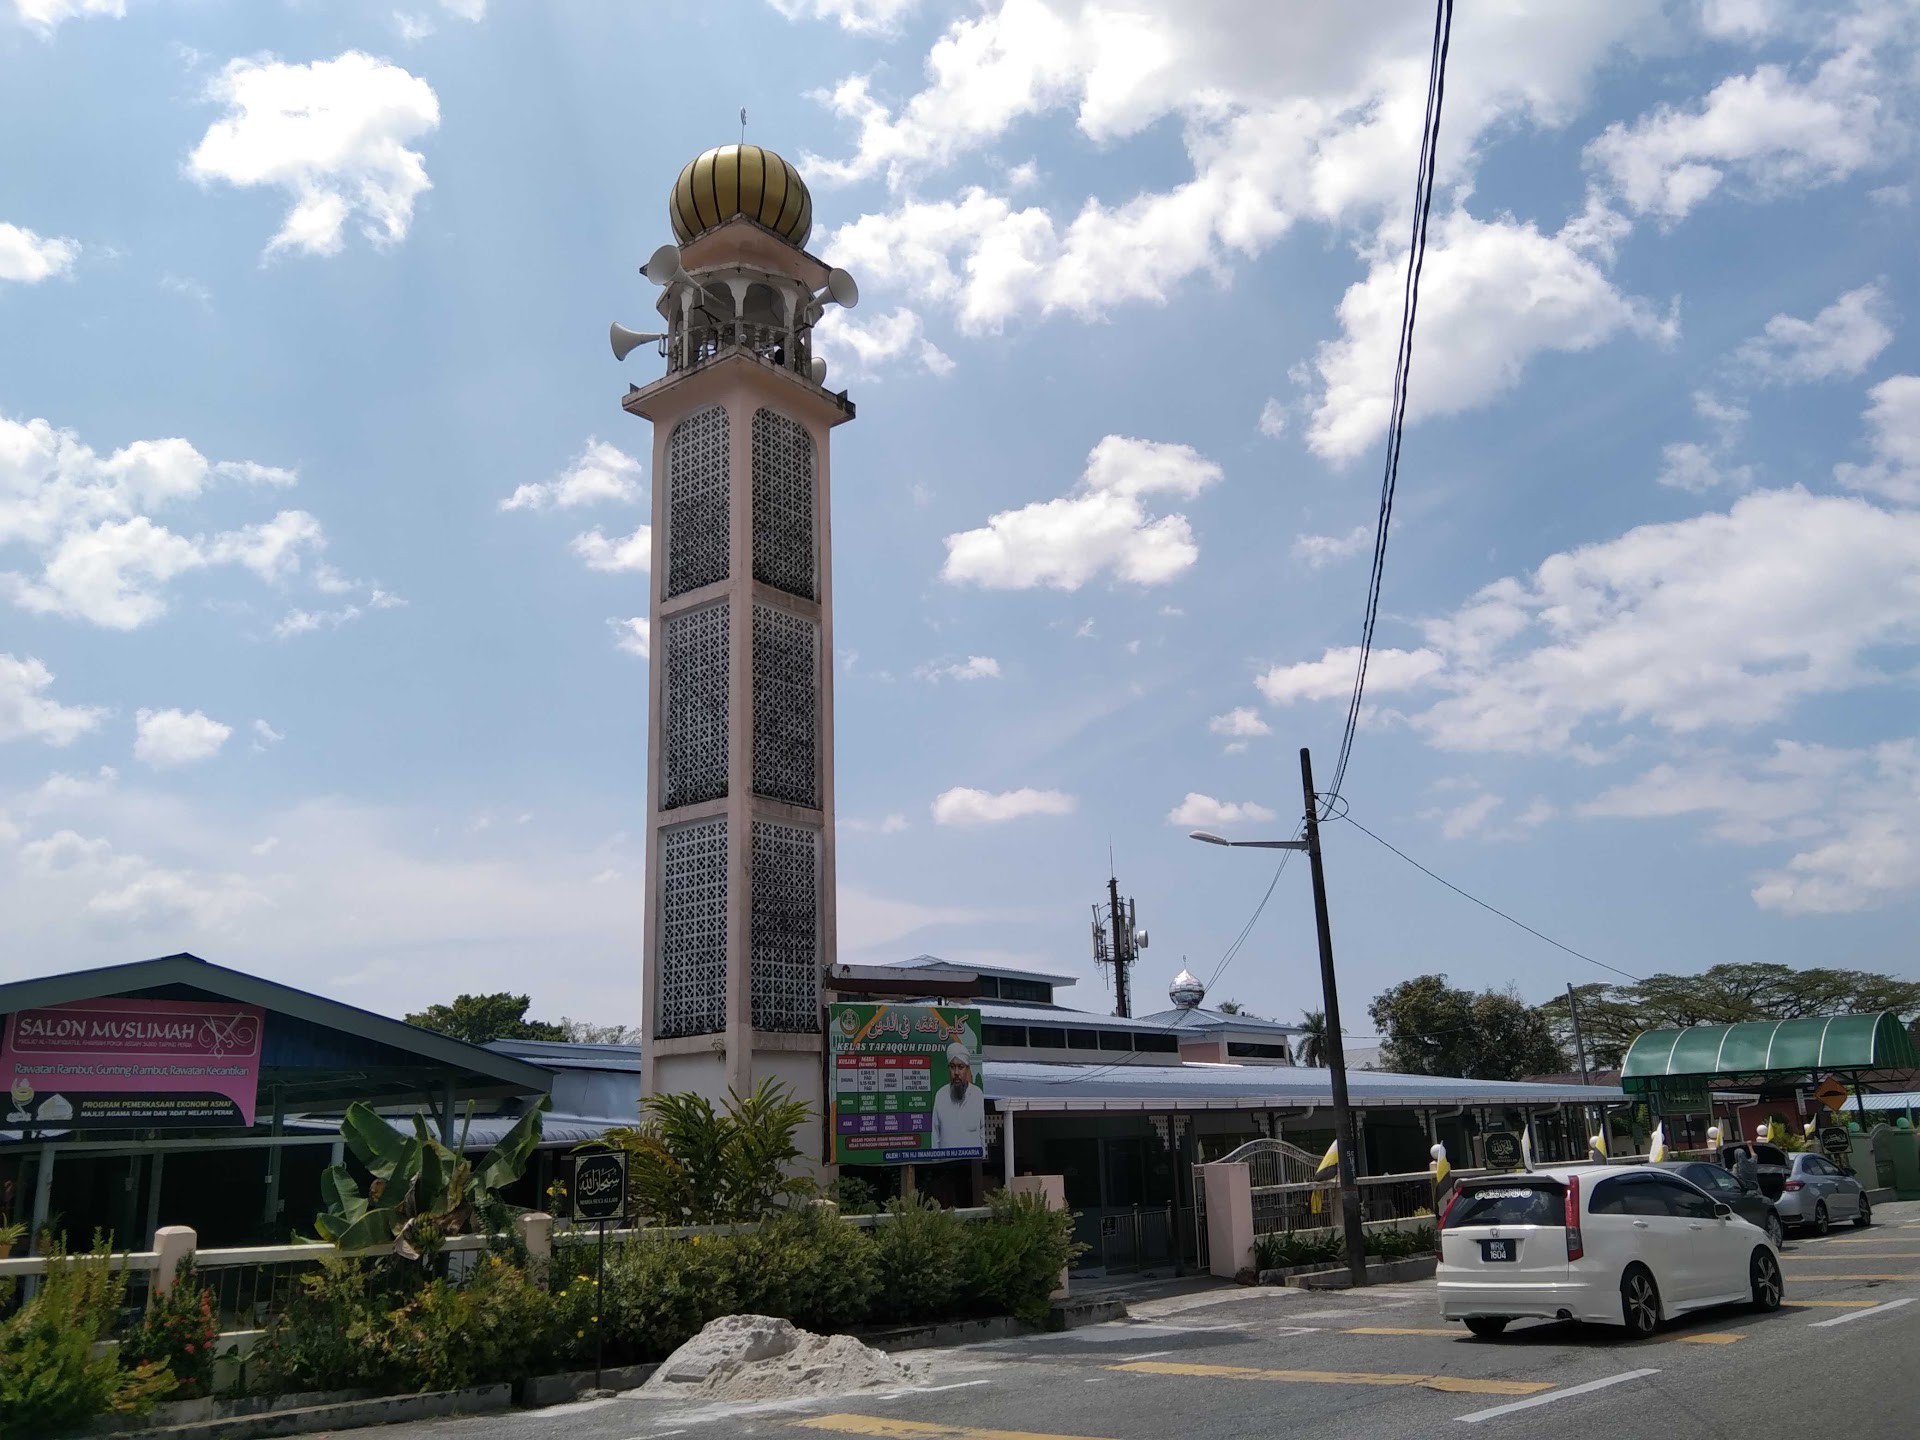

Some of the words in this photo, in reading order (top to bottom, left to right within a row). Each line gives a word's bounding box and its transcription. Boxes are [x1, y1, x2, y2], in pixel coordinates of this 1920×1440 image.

[19, 1018, 86, 1037] SALON
[90, 1020, 195, 1040] MUSLIMAH
[837, 1042, 866, 1052] KELAS
[868, 1042, 916, 1054] TAFAQQUH
[918, 1044, 947, 1052] FIDDIN
[15, 1064, 56, 1074] Rawatan
[57, 1064, 94, 1075] Rambut,
[96, 1064, 132, 1077] Gunting
[170, 1065, 205, 1075] Rawatan
[206, 1066, 248, 1076] Kecantikan
[1490, 1242, 1504, 1250] WRK
[1490, 1250, 1506, 1259] 1604
